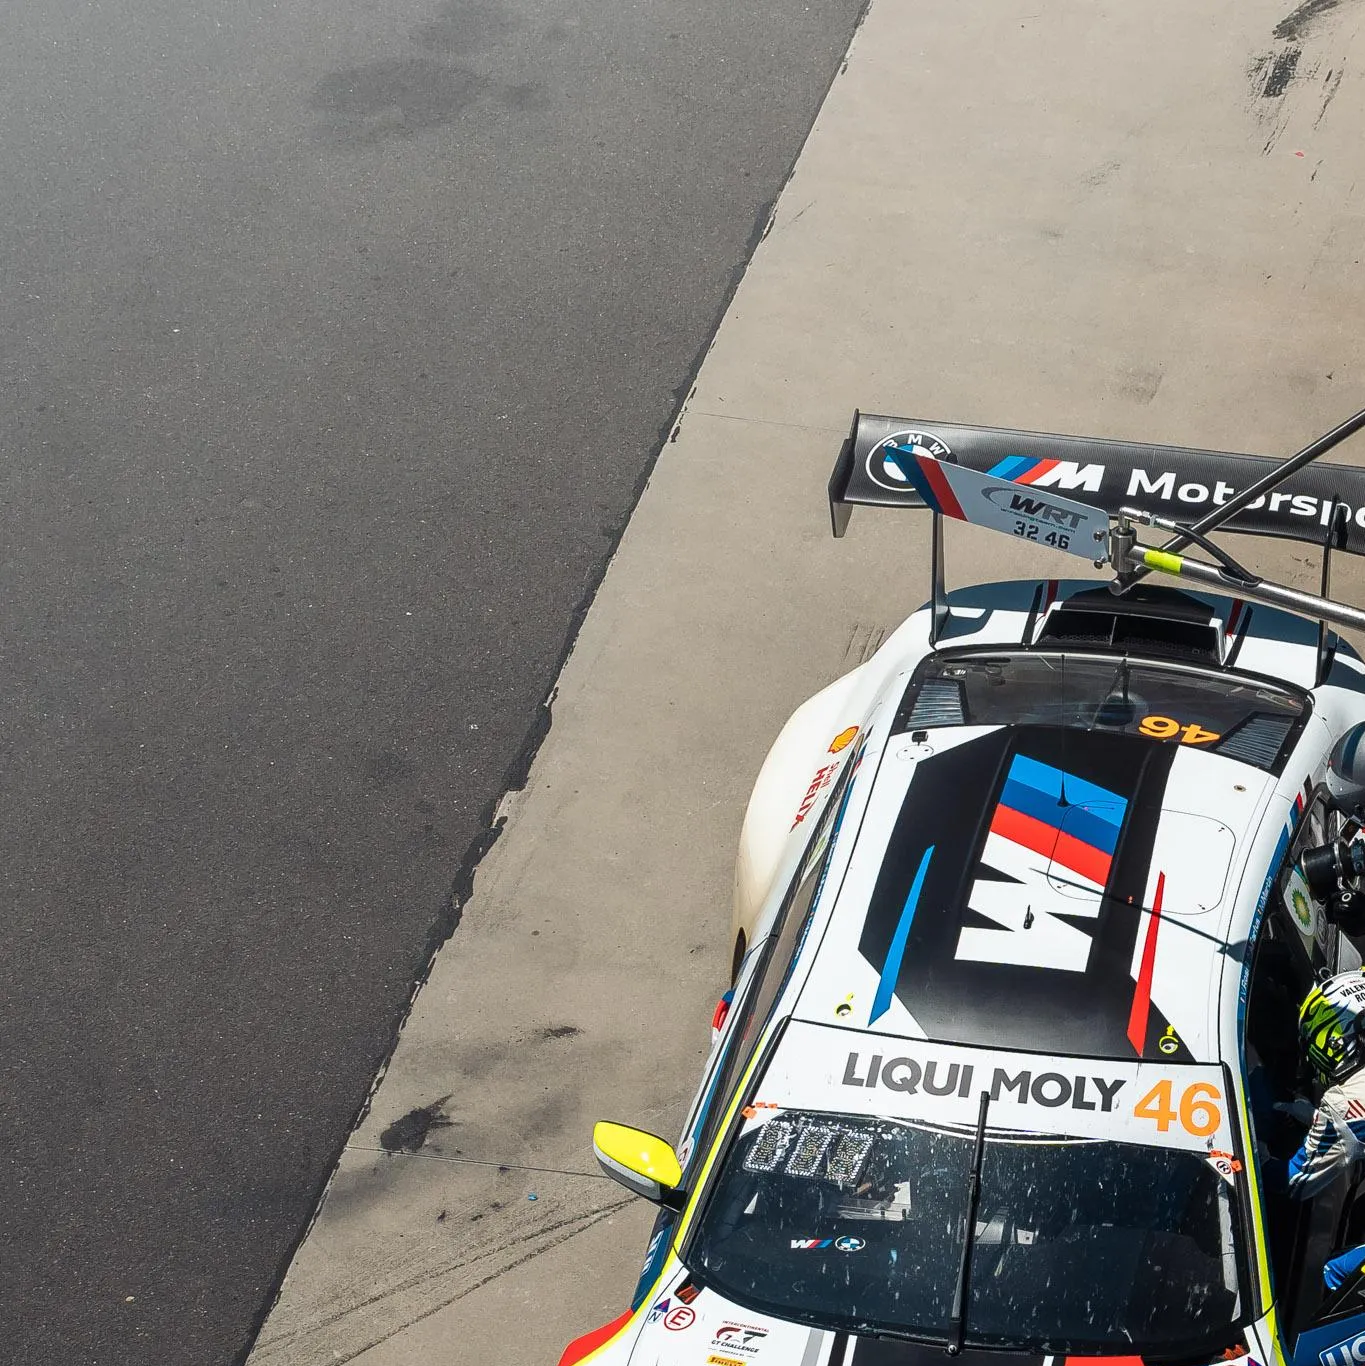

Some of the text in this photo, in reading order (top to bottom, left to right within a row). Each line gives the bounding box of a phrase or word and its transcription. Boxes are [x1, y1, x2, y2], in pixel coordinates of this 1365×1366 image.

[1009, 494, 1089, 530] WRT
[1013, 520, 1071, 550] 32 46
[841, 1051, 1222, 1137] LIQUI MOLY 46
[721, 1342, 760, 1353] CHALLENGE
